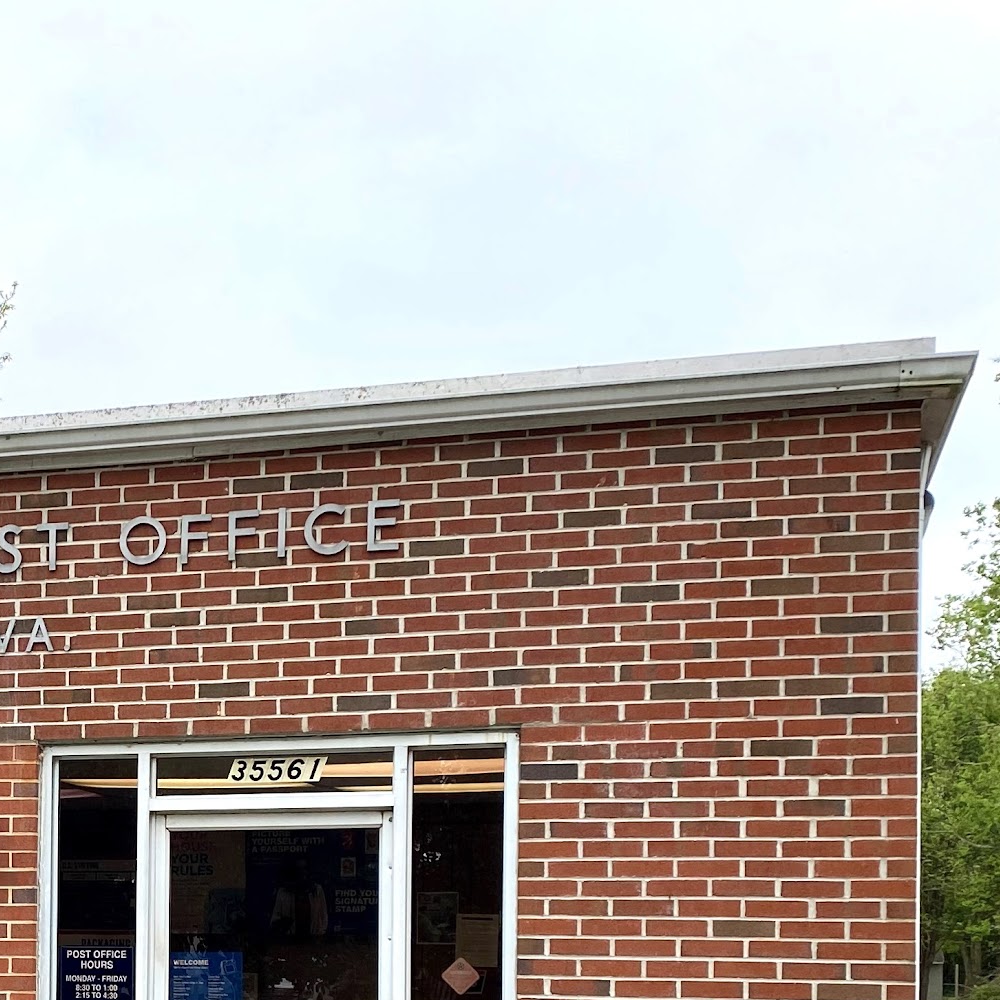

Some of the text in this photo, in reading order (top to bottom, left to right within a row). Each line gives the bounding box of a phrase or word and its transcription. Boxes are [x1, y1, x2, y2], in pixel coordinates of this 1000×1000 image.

[119, 499, 401, 566] OFFICE
[231, 758, 322, 782] 35561
[172, 853, 209, 864] YOUR
[171, 865, 214, 876] RULES
[66, 950, 127, 959] POST OFFICE
[80, 960, 114, 970] HOURS
[65, 975, 96, 983] MONDAY
[101, 975, 128, 983] FRIDAY
[75, 984, 118, 992] 8:30 TO 1:00
[75, 991, 118, 999] 2:15 TO 4:30
